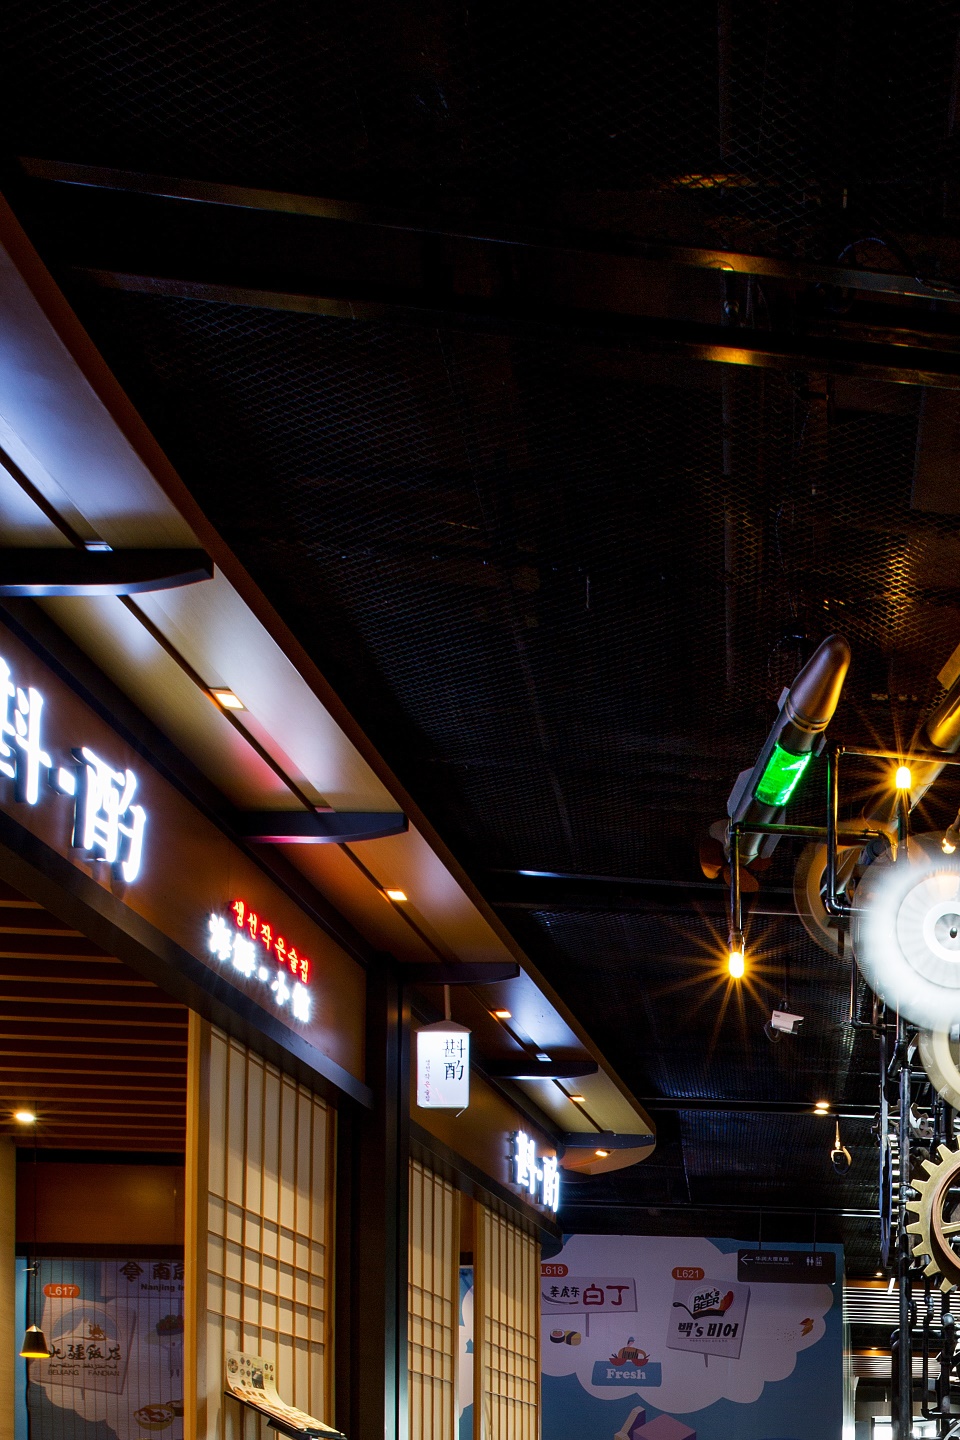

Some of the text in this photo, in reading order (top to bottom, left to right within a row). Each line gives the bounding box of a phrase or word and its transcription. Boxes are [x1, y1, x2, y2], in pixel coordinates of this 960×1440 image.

[443, 1038, 467, 1081] 斟酌
[541, 1266, 564, 1275] L618
[676, 1269, 700, 1278] L621
[49, 1286, 75, 1296] L617
[583, 1283, 630, 1306] 白丁
[693, 1296, 720, 1312] BEER
[707, 1322, 739, 1338] 비어
[606, 1368, 647, 1380] Fresh
